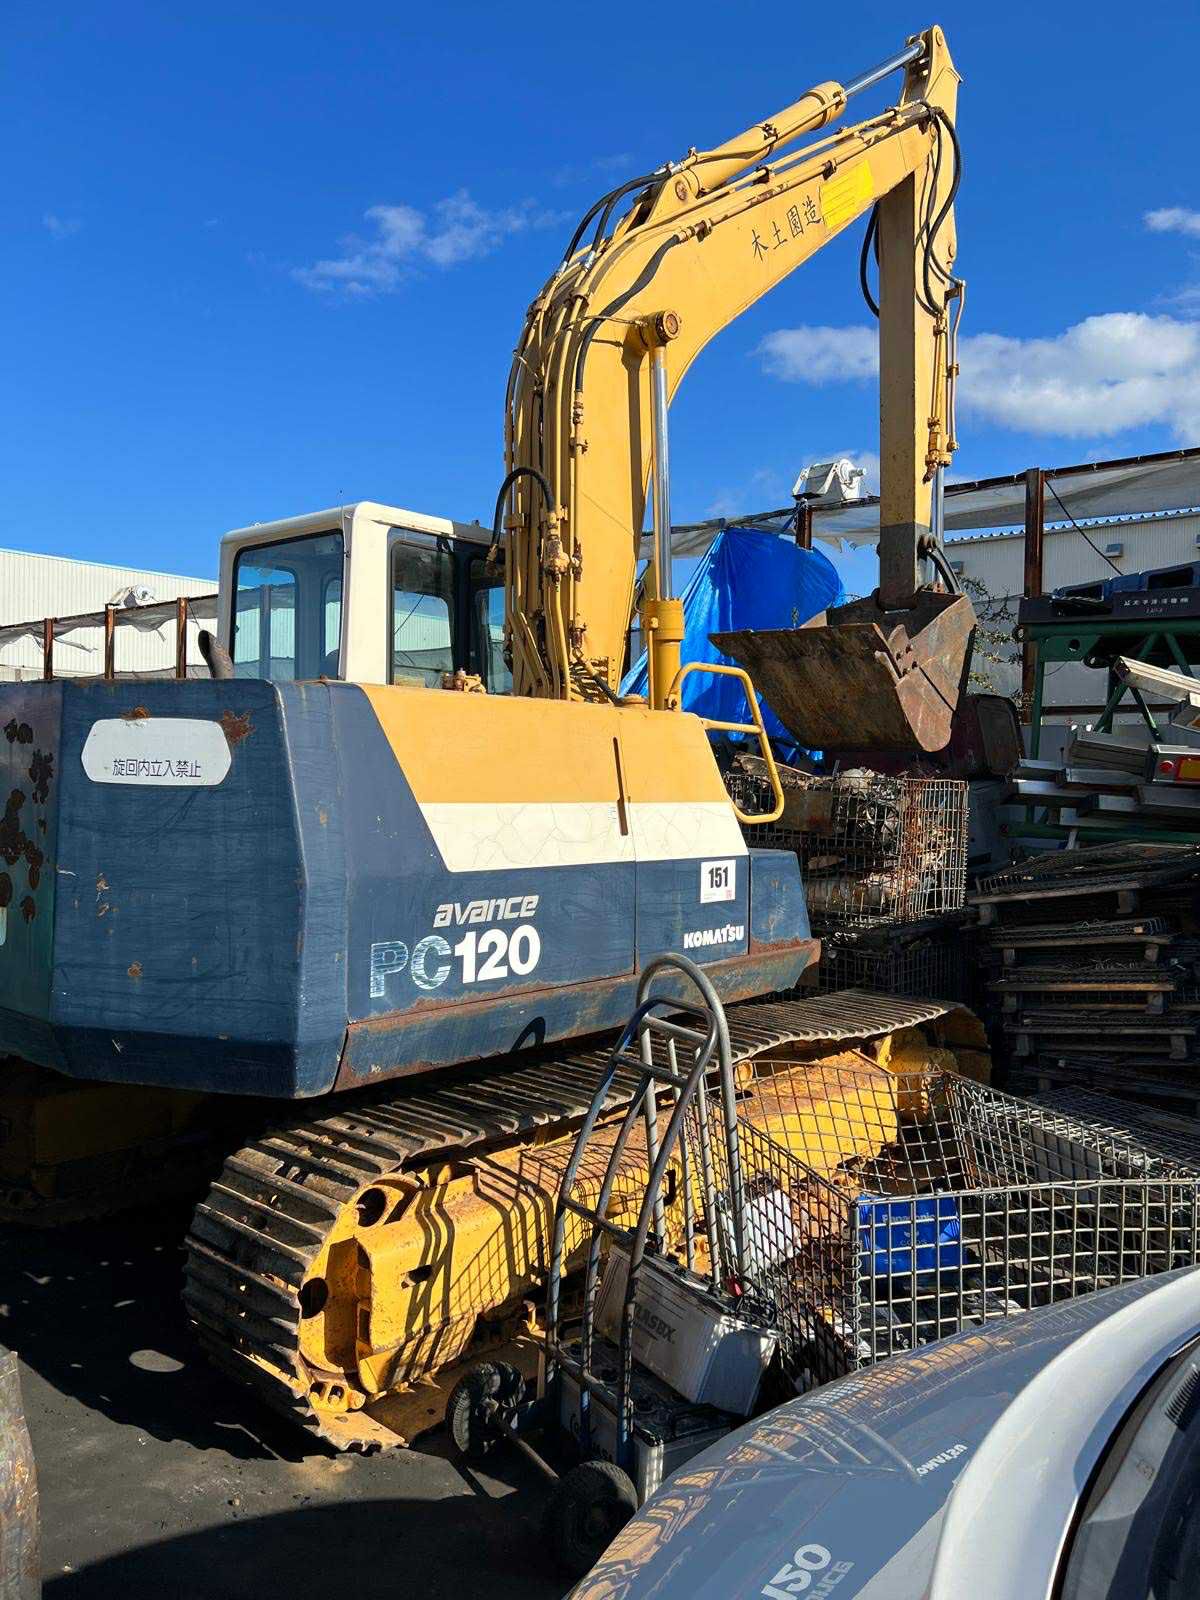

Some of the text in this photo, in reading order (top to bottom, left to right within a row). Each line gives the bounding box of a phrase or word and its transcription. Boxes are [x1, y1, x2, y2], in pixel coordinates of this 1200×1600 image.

[112, 758, 202, 778] 旋回内立入禁止
[708, 866, 729, 889] 151
[433, 895, 540, 928] avance
[683, 924, 745, 949] KOMATSU
[370, 925, 541, 998] PC120
